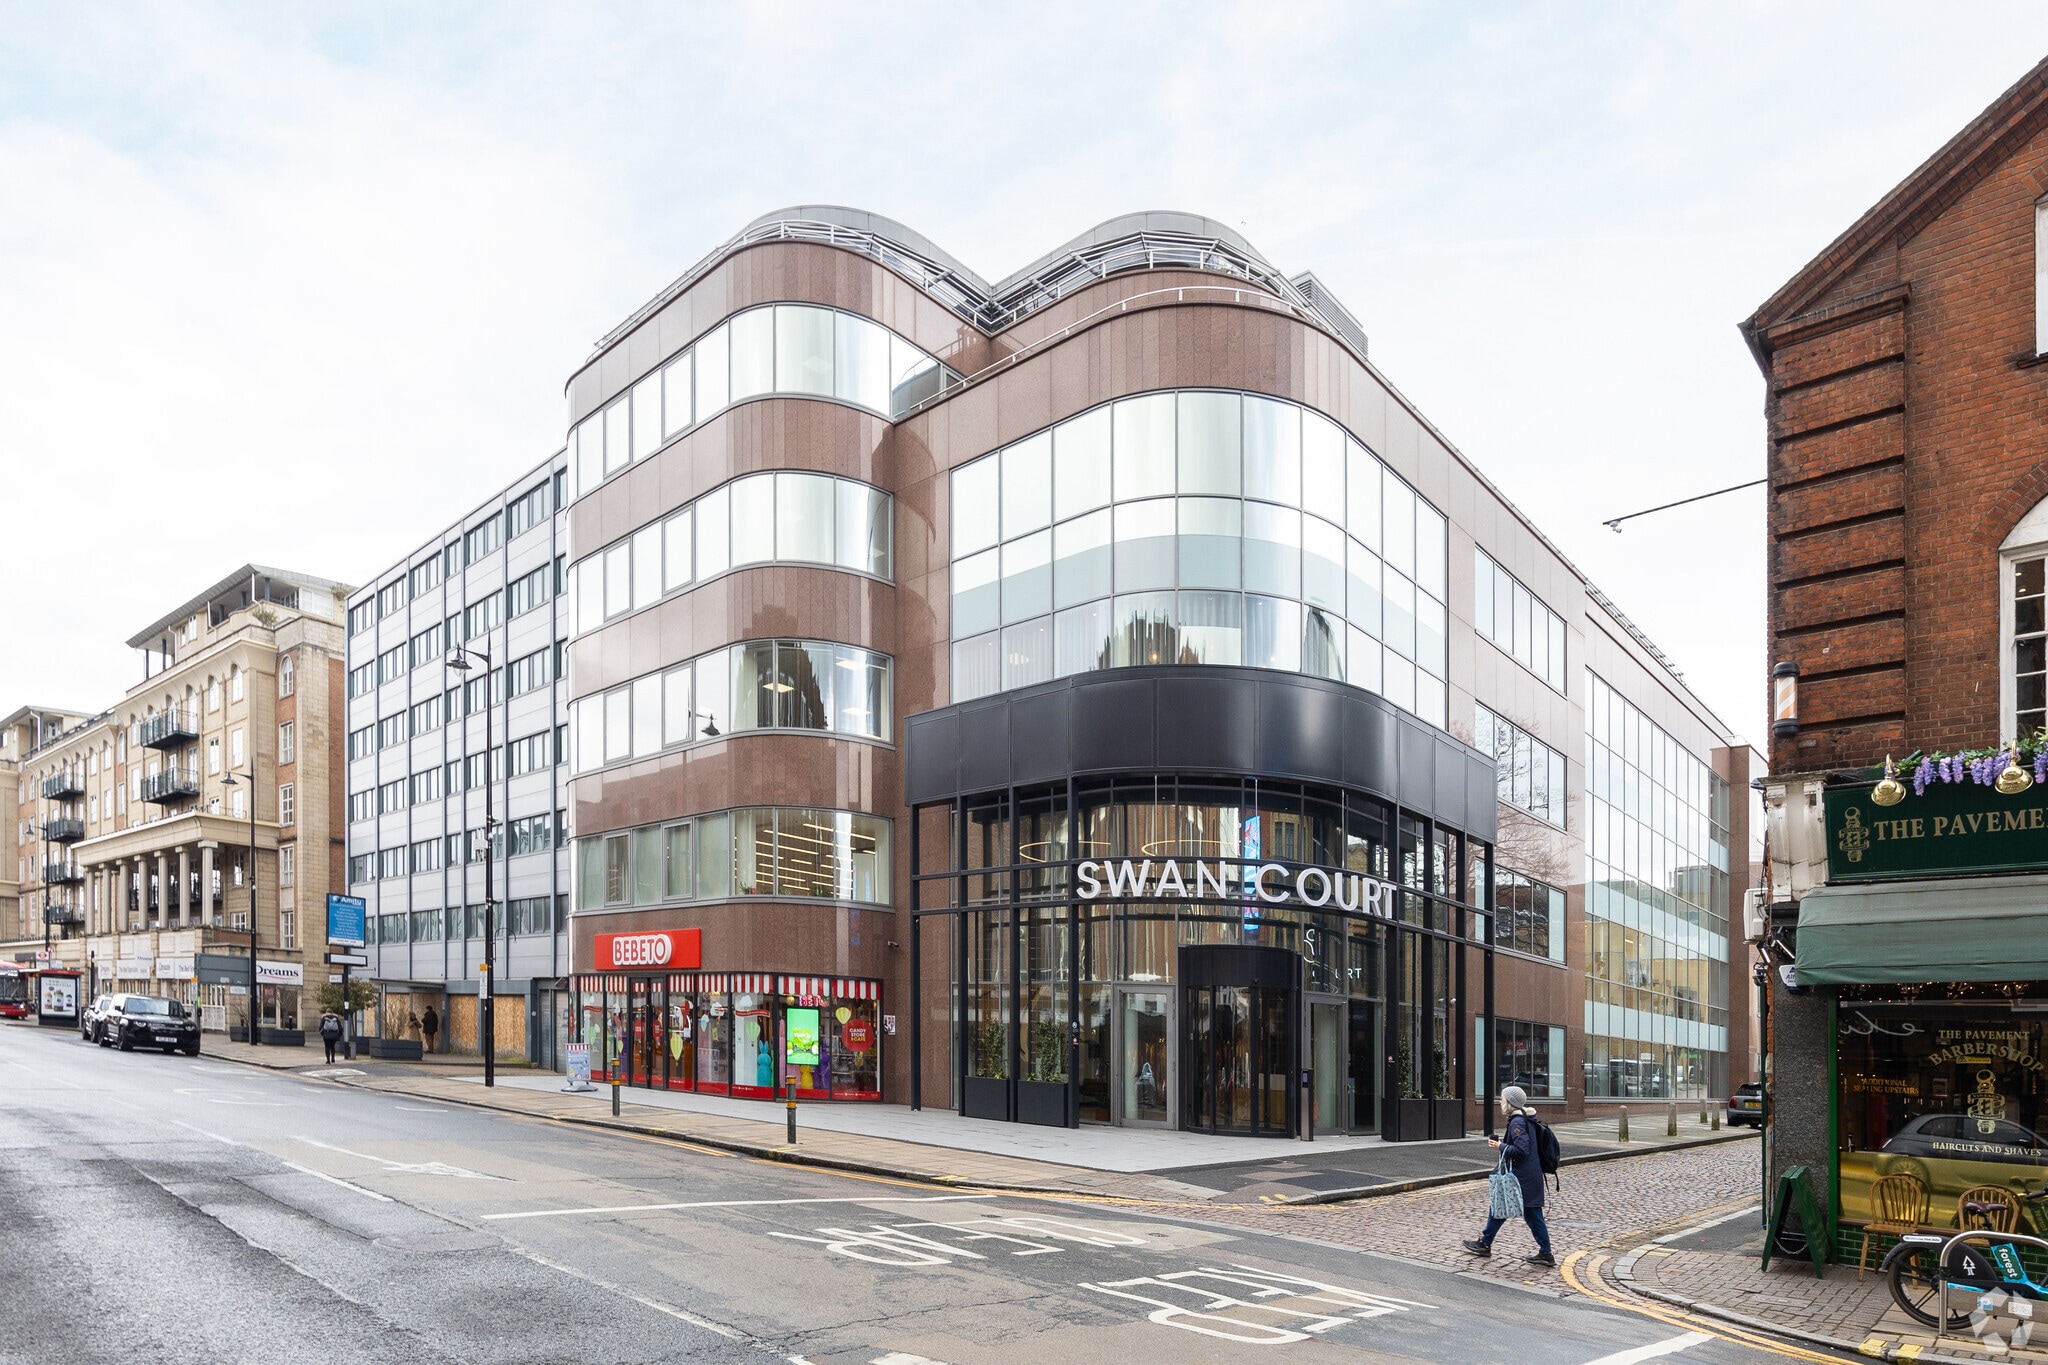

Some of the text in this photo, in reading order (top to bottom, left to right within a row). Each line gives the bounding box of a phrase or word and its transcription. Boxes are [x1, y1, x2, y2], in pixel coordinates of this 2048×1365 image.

[1873, 807, 2048, 841] THE PAVEME
[1076, 859, 1397, 919] SWAN COURT
[341, 896, 362, 906] Amity
[614, 936, 669, 963] BEBETO
[256, 965, 299, 977] Dreams
[1938, 1030, 2030, 1040] THE PAVEMENT
[1928, 1042, 2044, 1072] BARBERSHOP
[1884, 1086, 1920, 1095] UPSTAIRS
[1932, 1142, 2042, 1157] HAIRCUTS AND SHAVES
[1998, 1247, 2019, 1278] forest
